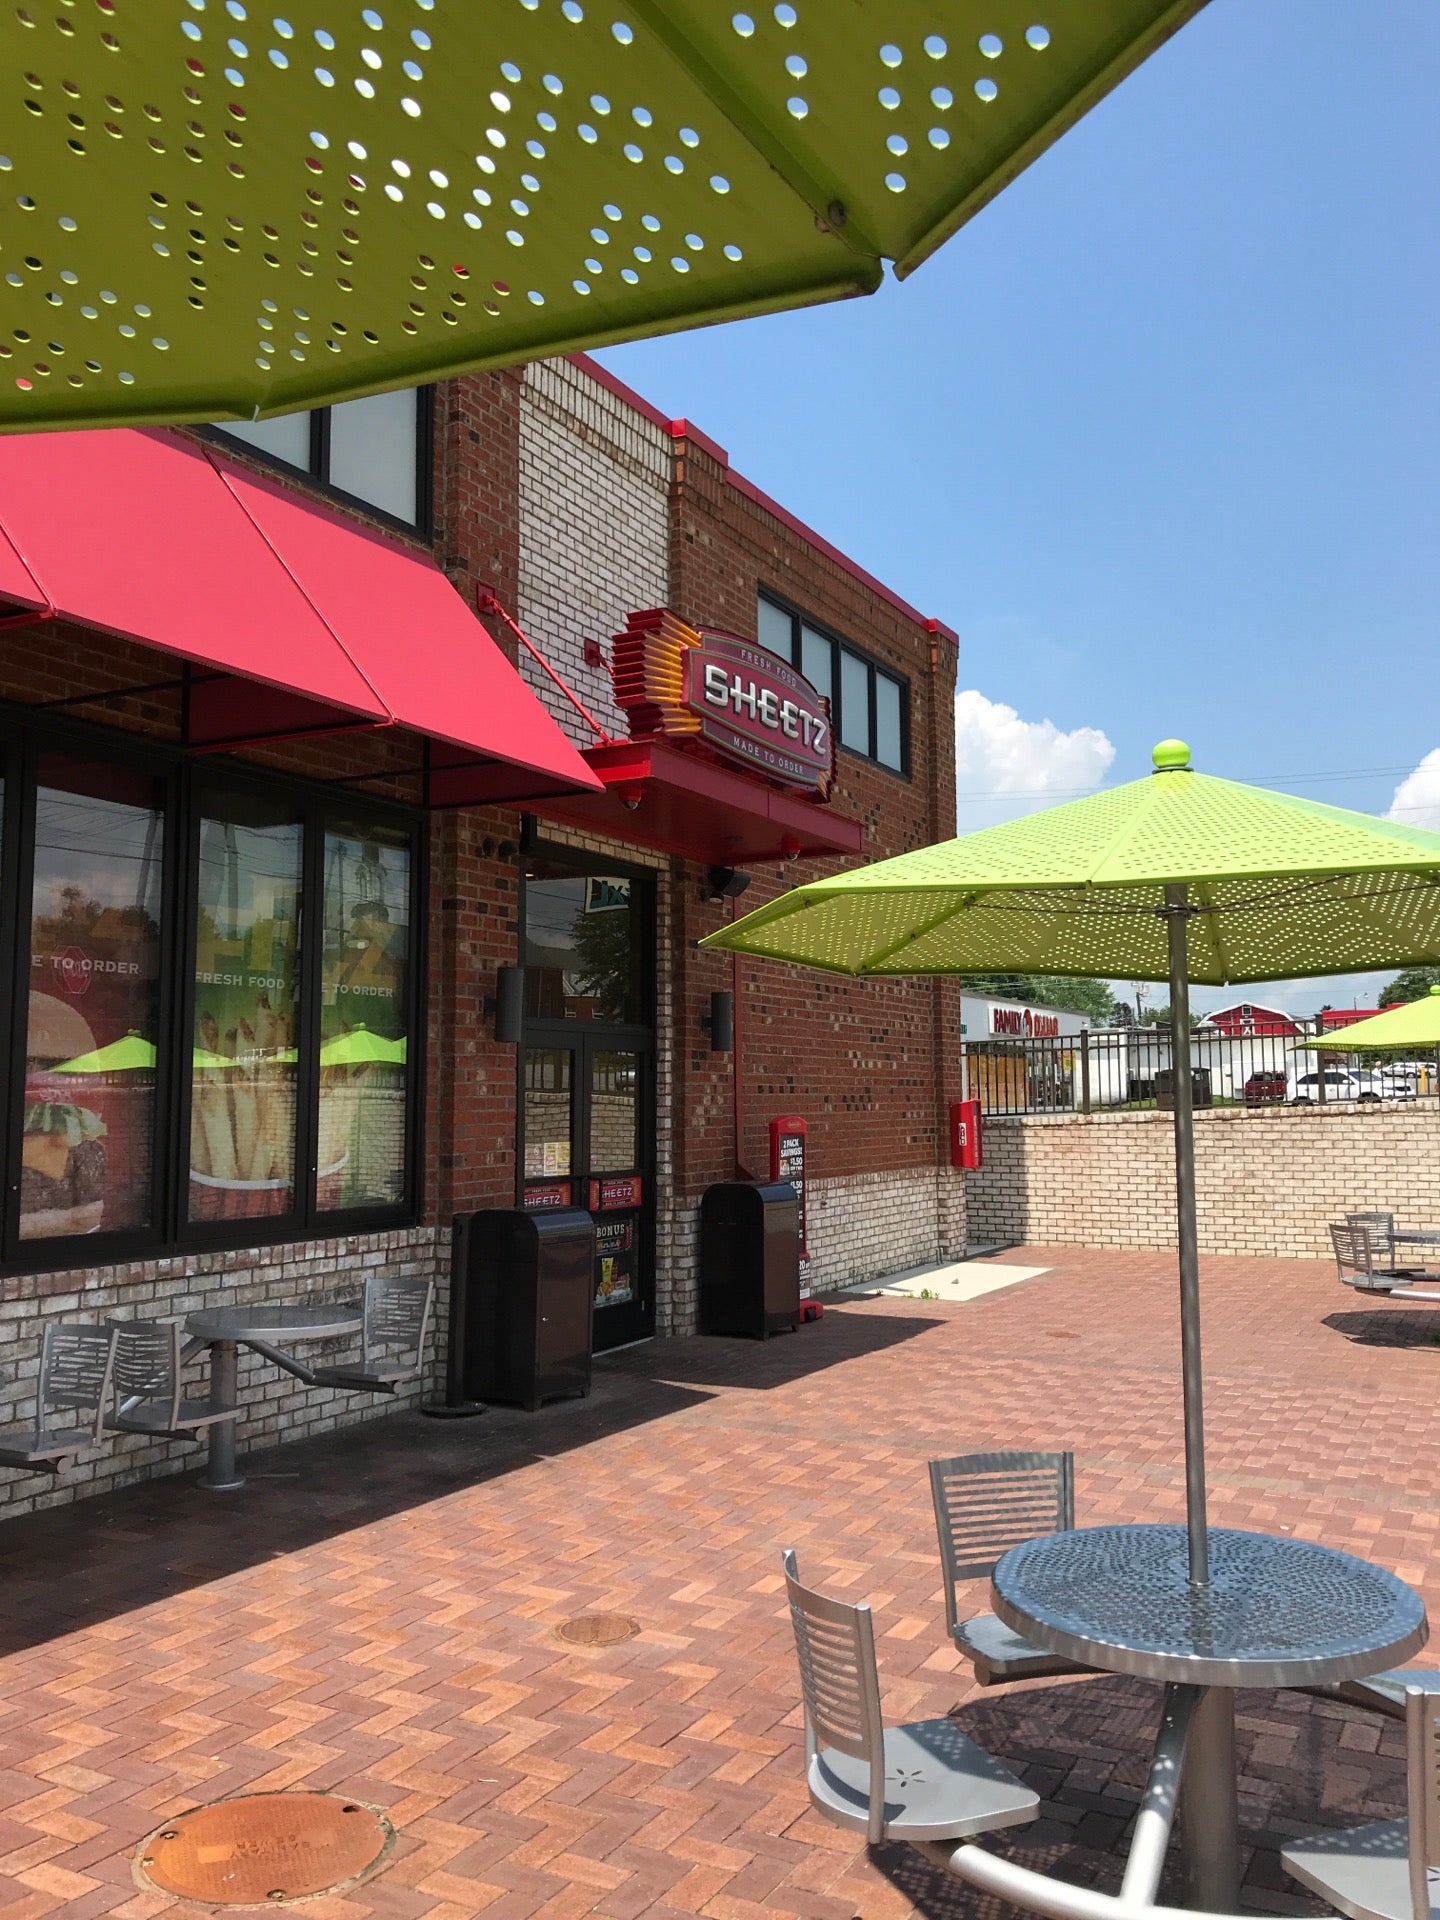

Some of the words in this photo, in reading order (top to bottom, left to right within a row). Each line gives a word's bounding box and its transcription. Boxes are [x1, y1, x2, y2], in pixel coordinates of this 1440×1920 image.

[741, 650, 772, 671] FRESH
[776, 667, 798, 687] FOOD
[704, 664, 827, 755] SHEETZ
[733, 735, 760, 757] MADE
[764, 752, 775, 764] TO
[778, 757, 804, 774] ORDER
[50, 956, 75, 970] TO
[195, 972, 243, 987] FRESH
[248, 976, 286, 990] FOOD
[333, 983, 349, 994] TO
[352, 985, 394, 998] ORDER
[994, 1008, 1022, 1036] FAMILY
